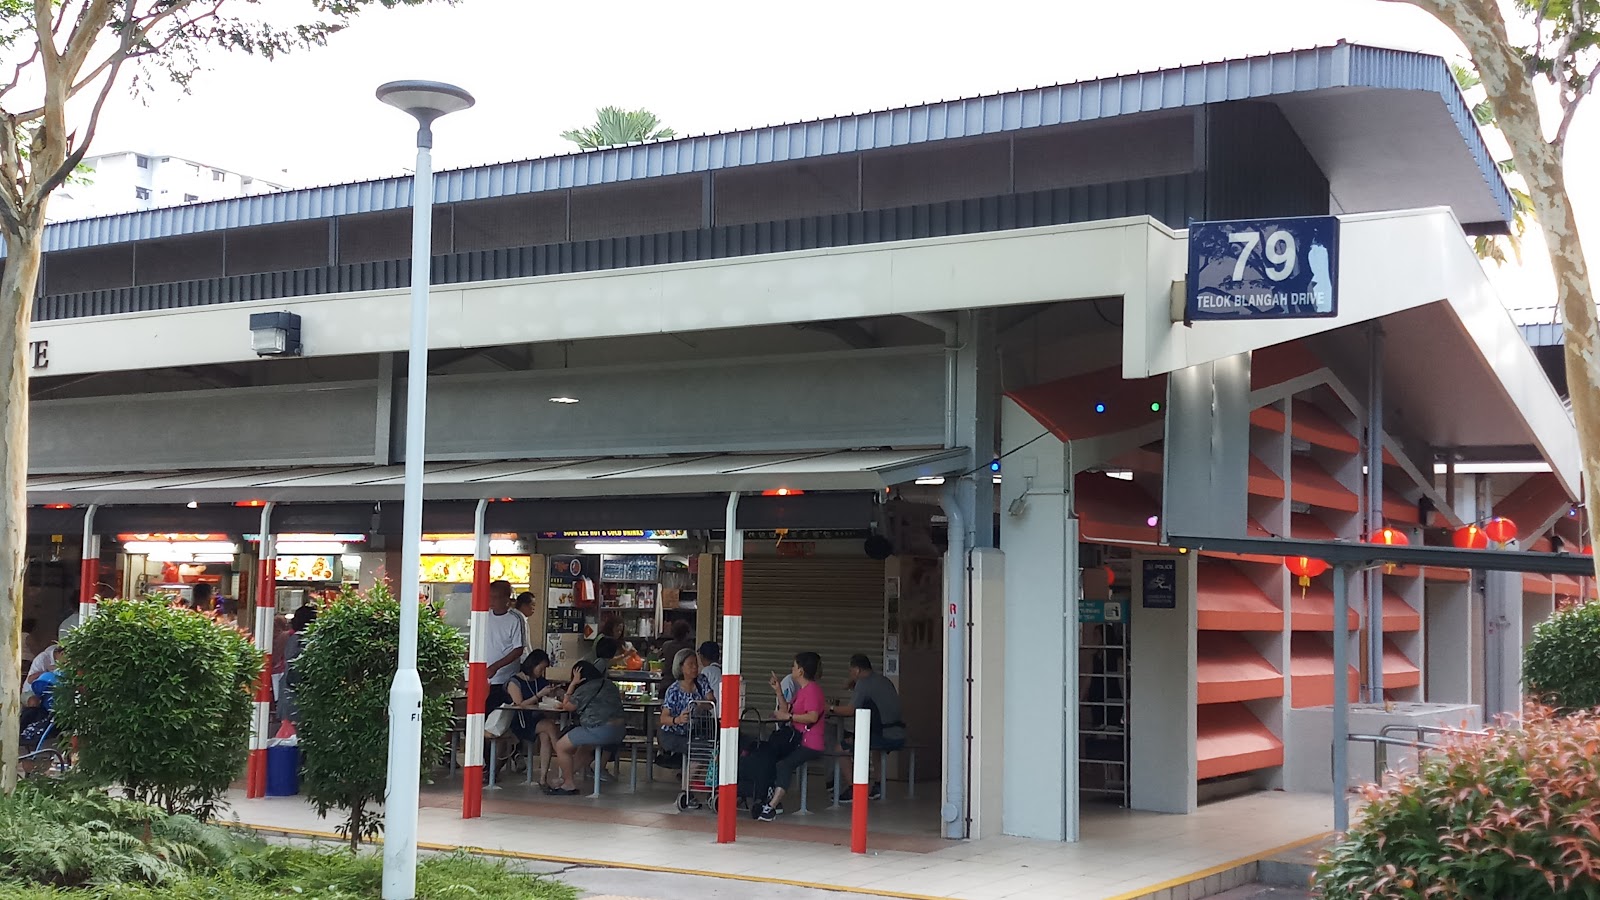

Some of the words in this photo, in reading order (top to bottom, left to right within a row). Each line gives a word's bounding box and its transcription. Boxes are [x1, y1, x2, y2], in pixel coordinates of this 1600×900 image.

[1228, 230, 1296, 282] 79
[1197, 294, 1232, 308] TELOK
[1234, 292, 1288, 307] BLANGAH
[1291, 292, 1324, 305] DRIVE
[29, 340, 49, 369] E
